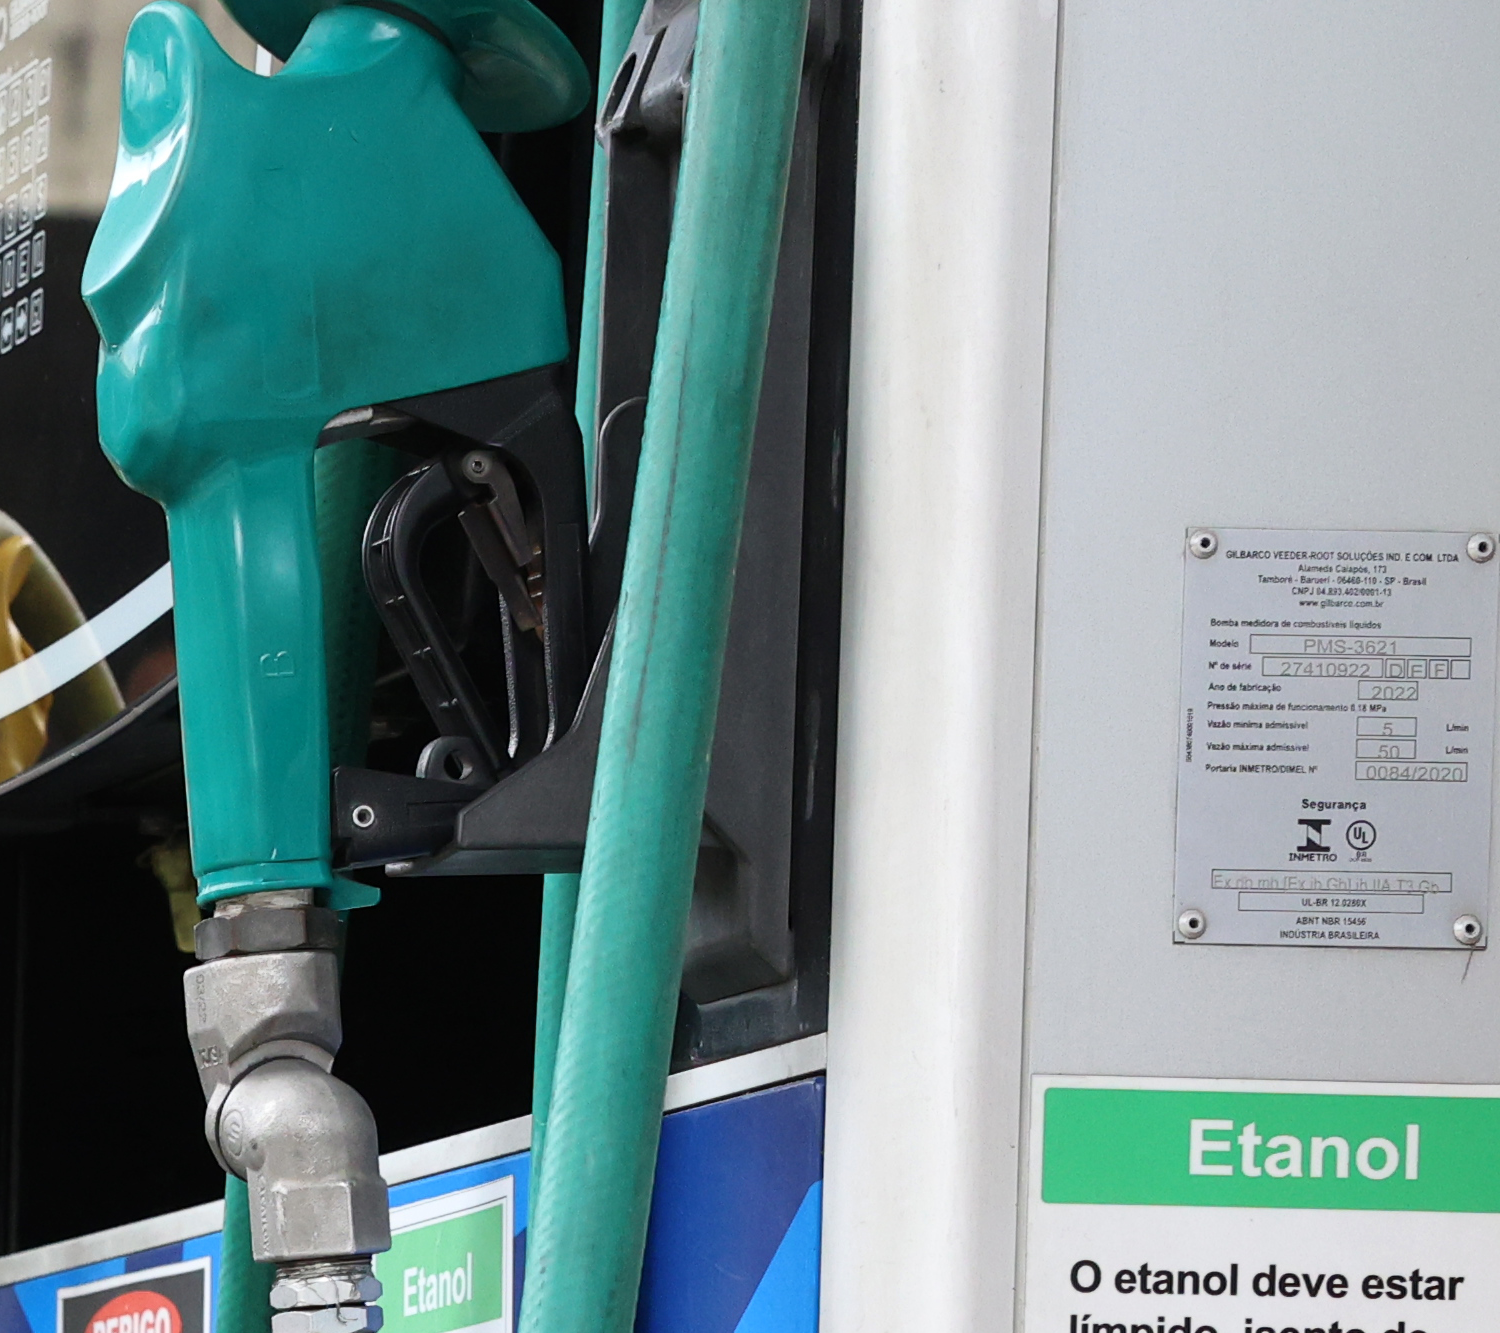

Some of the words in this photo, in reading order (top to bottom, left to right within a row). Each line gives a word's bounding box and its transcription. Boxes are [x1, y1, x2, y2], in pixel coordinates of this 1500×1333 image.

[1304, 639, 1397, 655] PMS-3621
[1280, 662, 1370, 677] 27410922
[1372, 685, 1417, 700] 2022
[1383, 722, 1393, 737] 5
[1366, 765, 1463, 781] 0084/2020
[1302, 799, 1367, 811] Segurança
[1289, 853, 1337, 862] INMETRO
[1187, 1118, 1420, 1181] Etanol
[404, 1252, 473, 1317] Etanol
[1069, 1260, 1101, 1294] O
[1114, 1263, 1238, 1297] etanol
[1252, 1265, 1348, 1299] deve
[1361, 1269, 1464, 1302] estar
